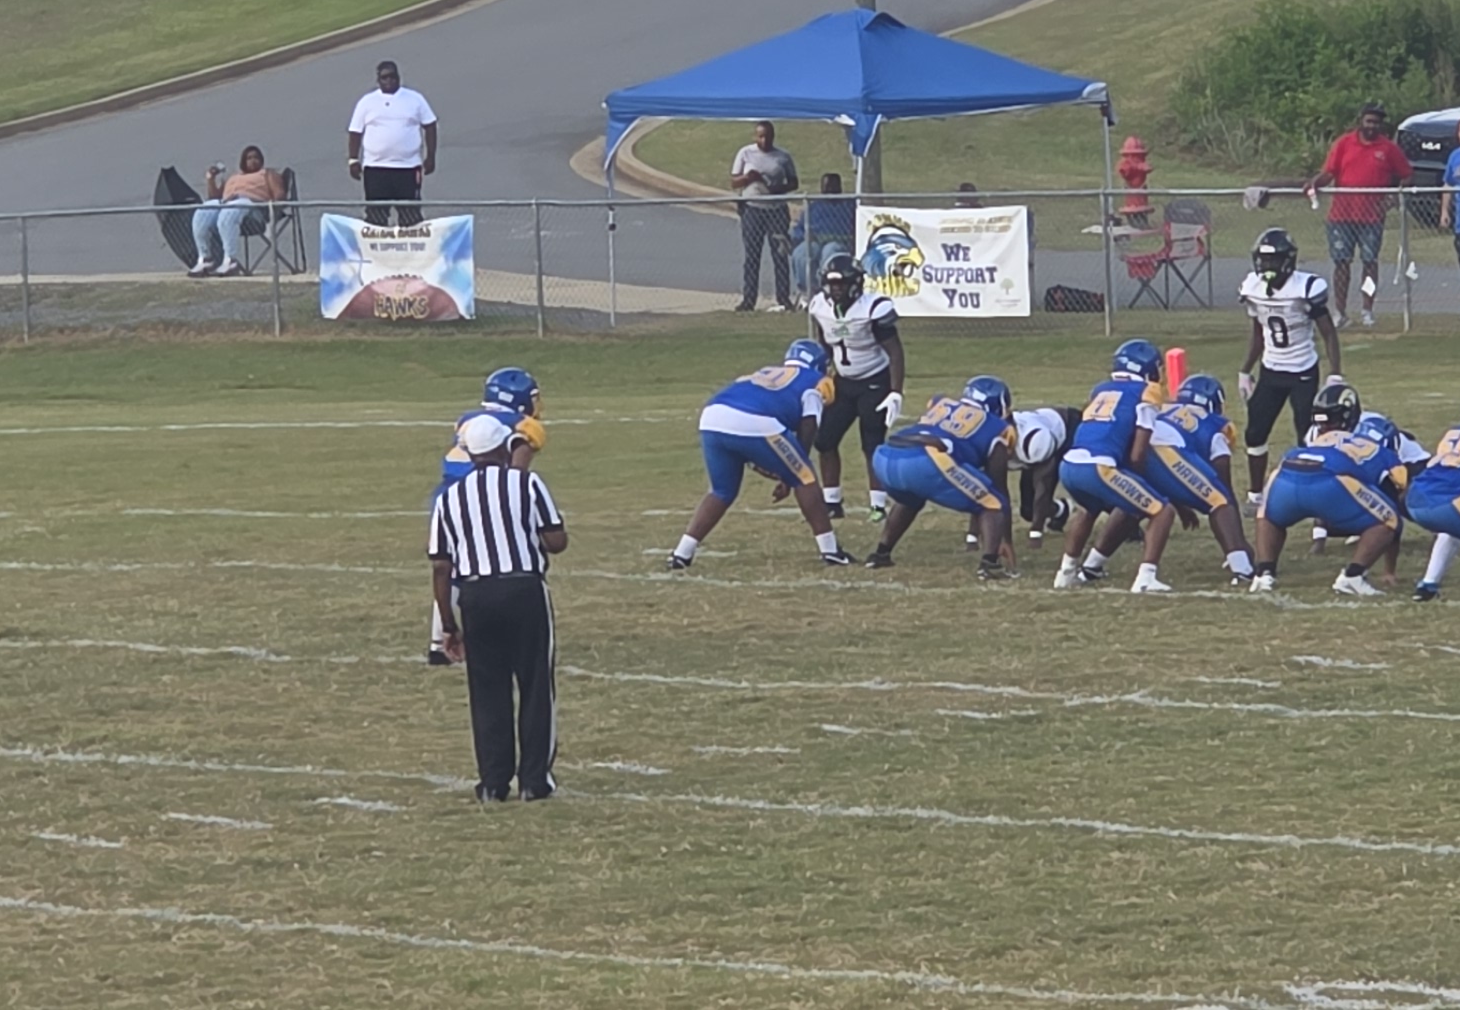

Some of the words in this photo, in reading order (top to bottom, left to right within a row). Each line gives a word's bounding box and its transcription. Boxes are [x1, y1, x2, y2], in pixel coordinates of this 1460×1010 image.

[941, 243, 971, 262] WE
[922, 265, 998, 284] SUPPORT
[374, 293, 431, 320] HAWKS
[942, 288, 981, 309] YOU
[946, 466, 989, 500] HAWKS
[1110, 474, 1153, 509] HAWKS
[1172, 460, 1213, 497] HAWKS
